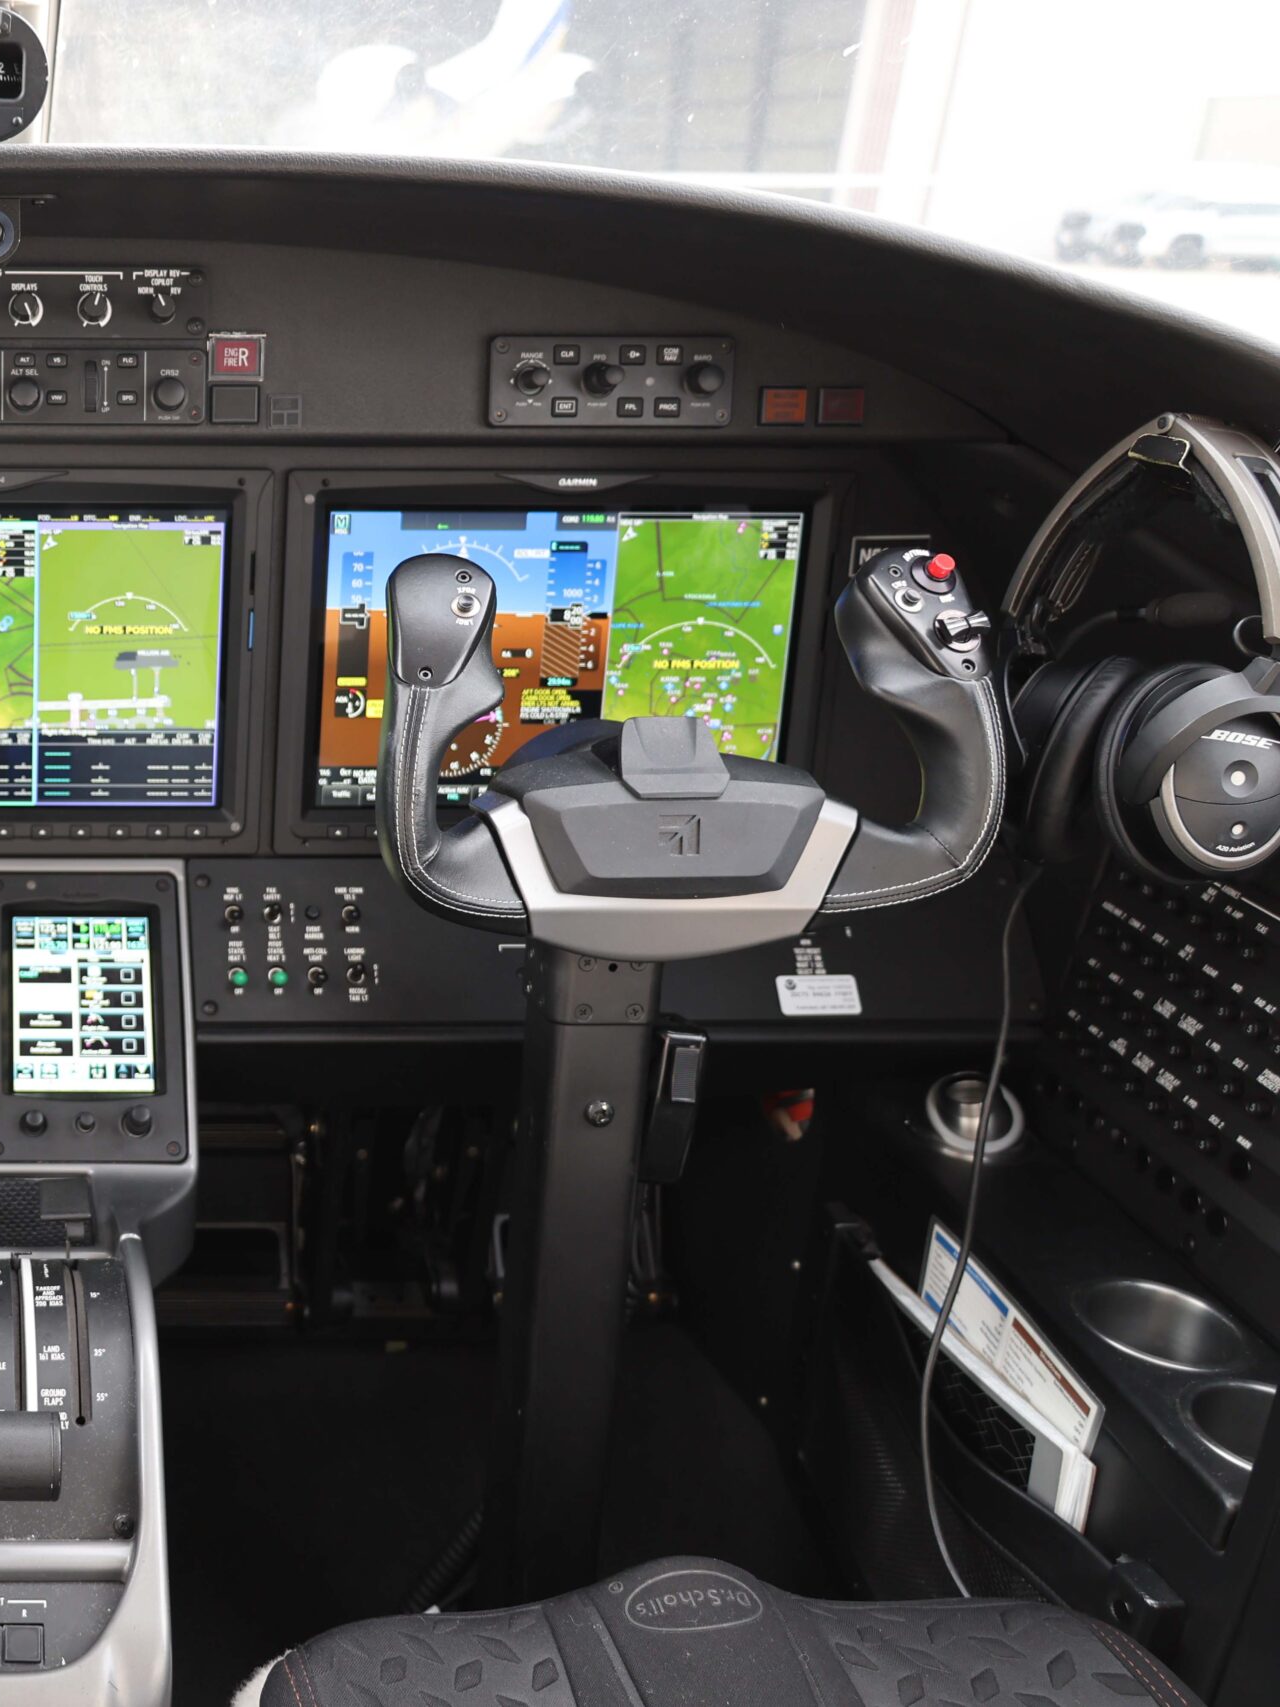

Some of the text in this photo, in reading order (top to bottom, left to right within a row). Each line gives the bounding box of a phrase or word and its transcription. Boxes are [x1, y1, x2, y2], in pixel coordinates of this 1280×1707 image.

[12, 283, 37, 291] DISPLAYS
[224, 347, 238, 356] ENG
[239, 348, 248, 366] R
[224, 358, 238, 366] FIRE
[558, 478, 597, 486] GARMIN
[352, 563, 364, 572] 70
[352, 579, 363, 588] 60
[563, 589, 583, 597] 1000
[653, 660, 669, 668] NO
[693, 660, 739, 668] POSITION
[1207, 729, 1274, 749] BOSE
[41, 1389, 66, 1397] GROUND
[44, 1398, 63, 1406] FLAPS
